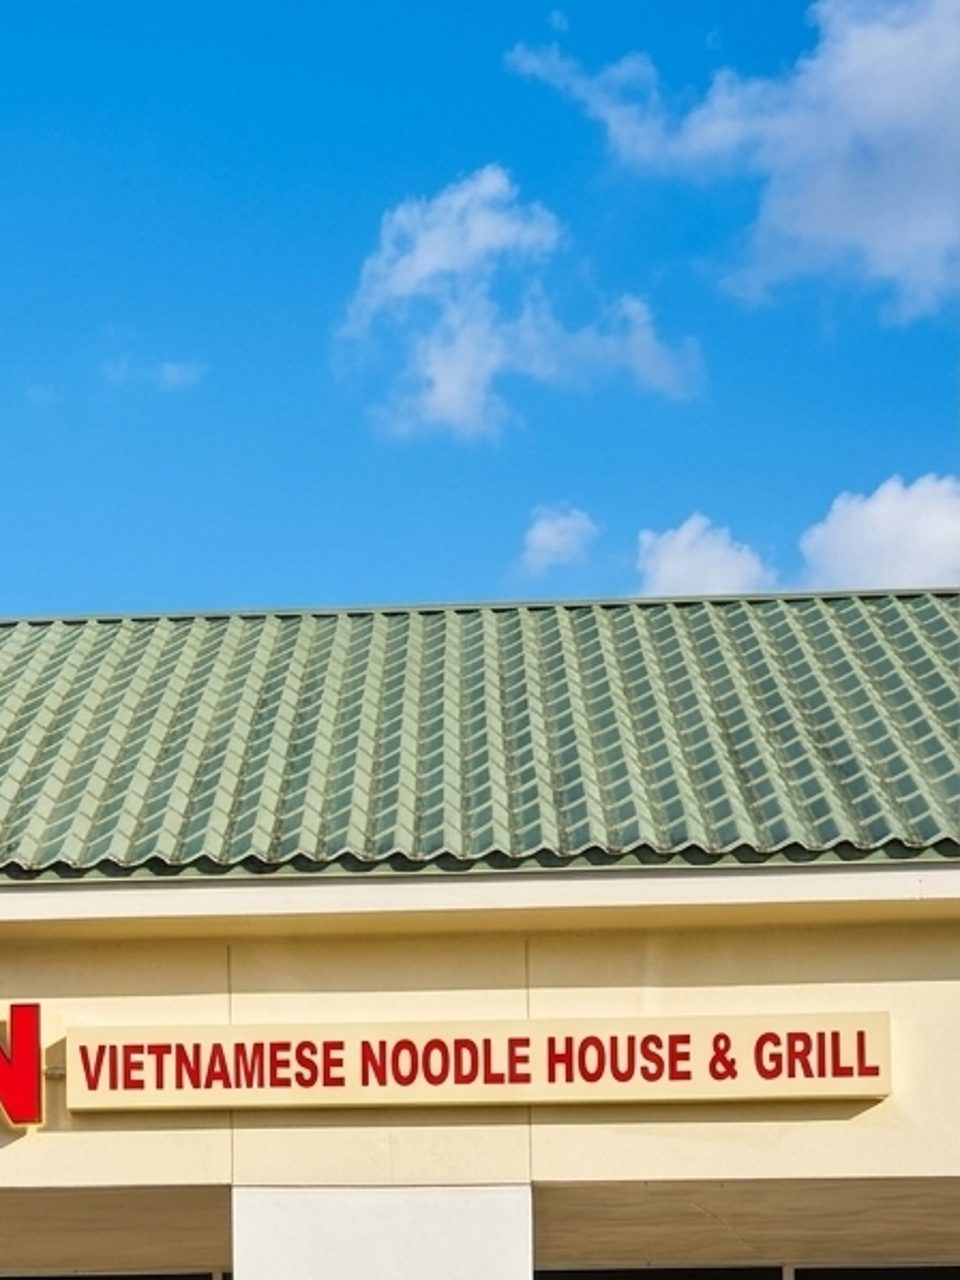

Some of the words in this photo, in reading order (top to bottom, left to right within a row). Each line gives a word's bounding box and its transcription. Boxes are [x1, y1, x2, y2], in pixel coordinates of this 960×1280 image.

[79, 1041, 345, 1091] VIETNAMESE
[361, 1038, 531, 1087] NOODLE
[547, 1034, 691, 1083] HOUSE
[709, 1033, 738, 1081] &
[754, 1030, 880, 1080] GRILL
